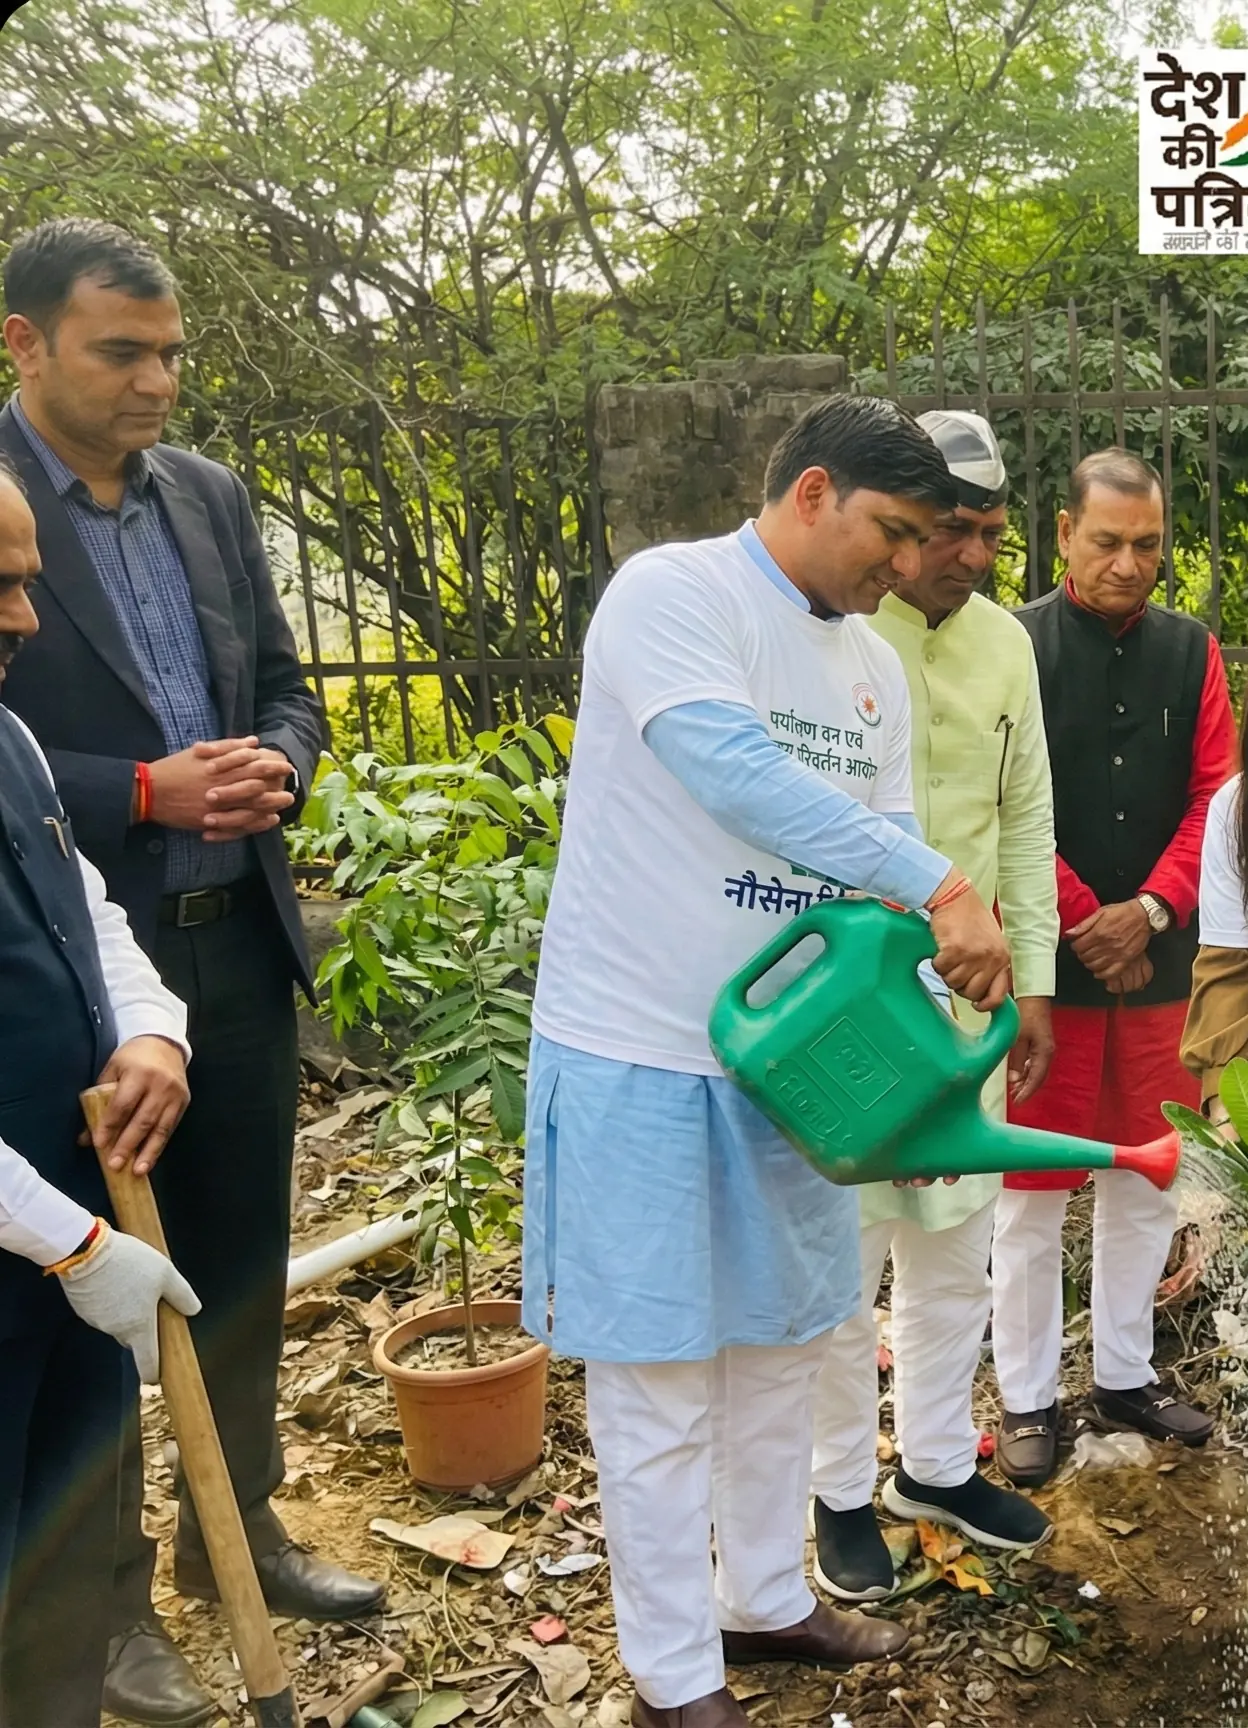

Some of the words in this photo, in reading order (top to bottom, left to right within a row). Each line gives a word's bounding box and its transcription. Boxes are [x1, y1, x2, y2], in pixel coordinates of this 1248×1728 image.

[821, 725, 841, 745] वन
[845, 729, 863, 750] एवं
[724, 870, 813, 916] नौसेना
